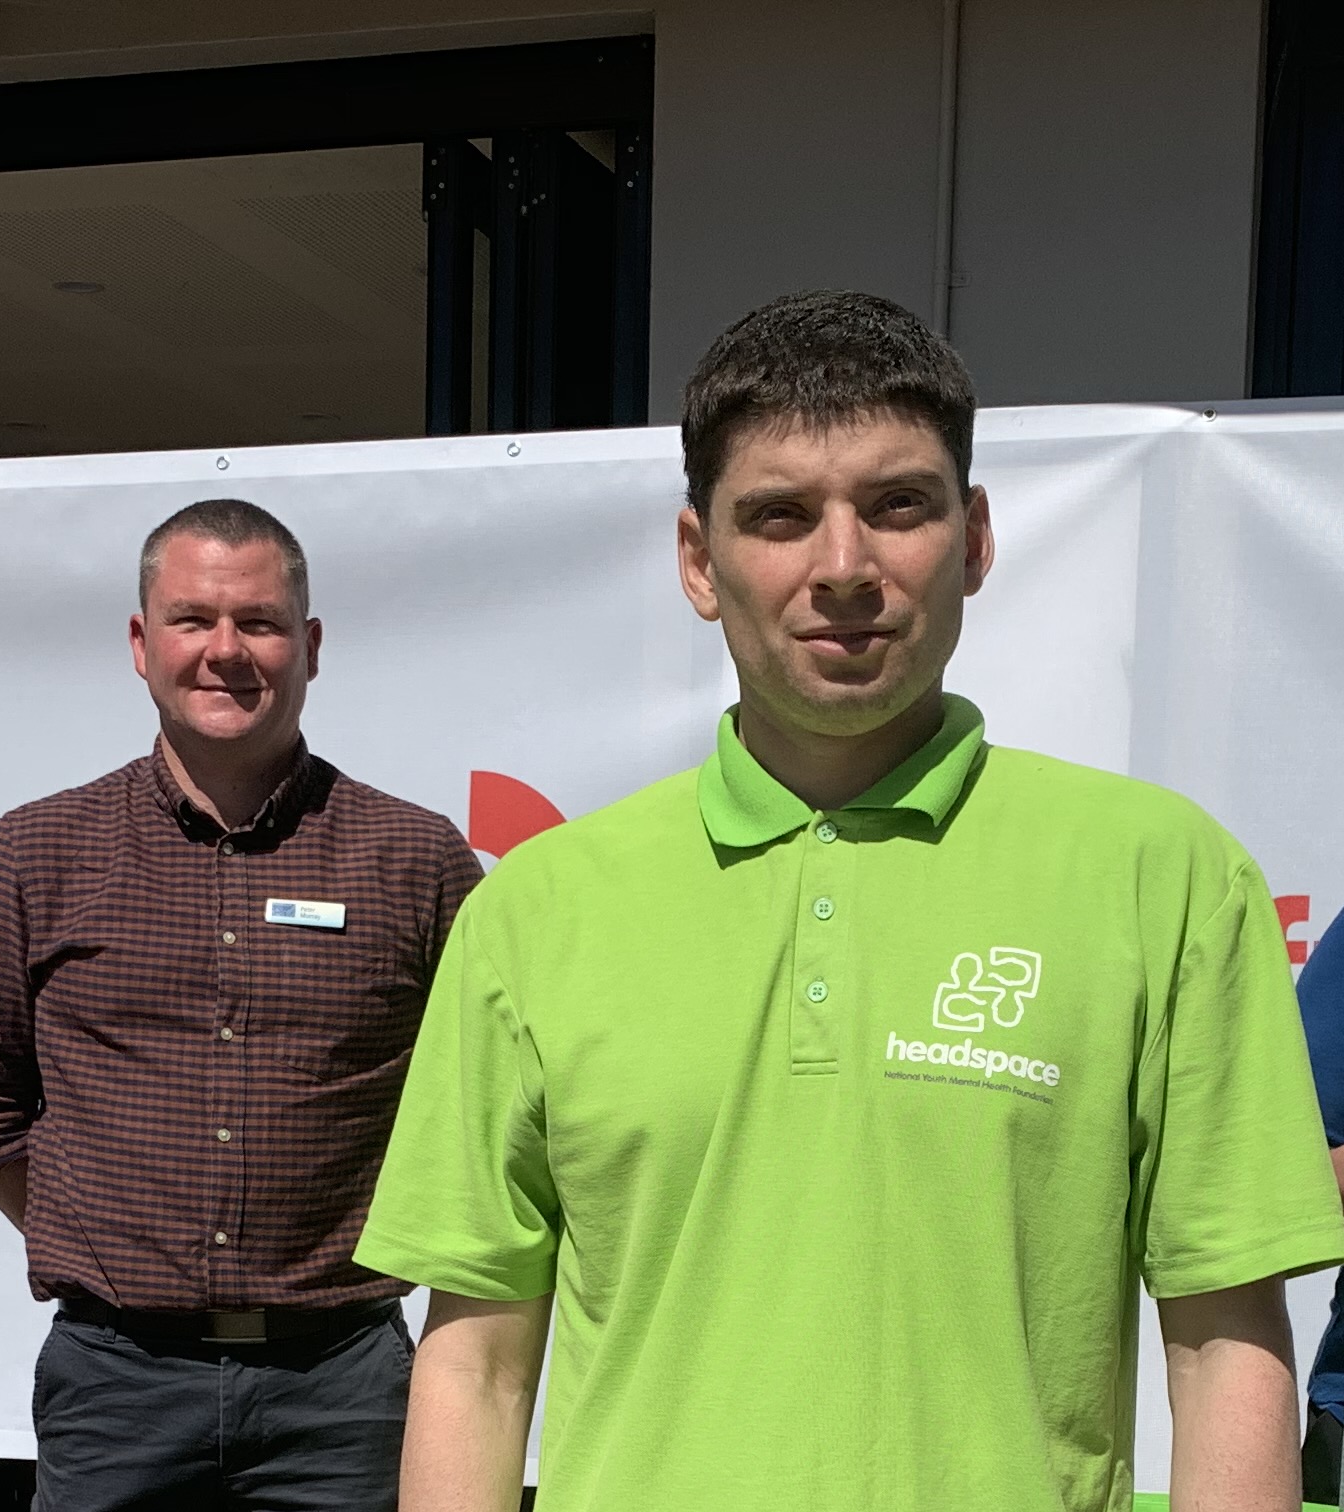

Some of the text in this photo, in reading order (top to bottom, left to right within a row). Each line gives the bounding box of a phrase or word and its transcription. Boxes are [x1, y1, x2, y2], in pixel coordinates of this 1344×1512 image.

[885, 1031, 1061, 1087] headspace
[884, 1071, 1055, 1105] National Youth Mental Health Foundation
